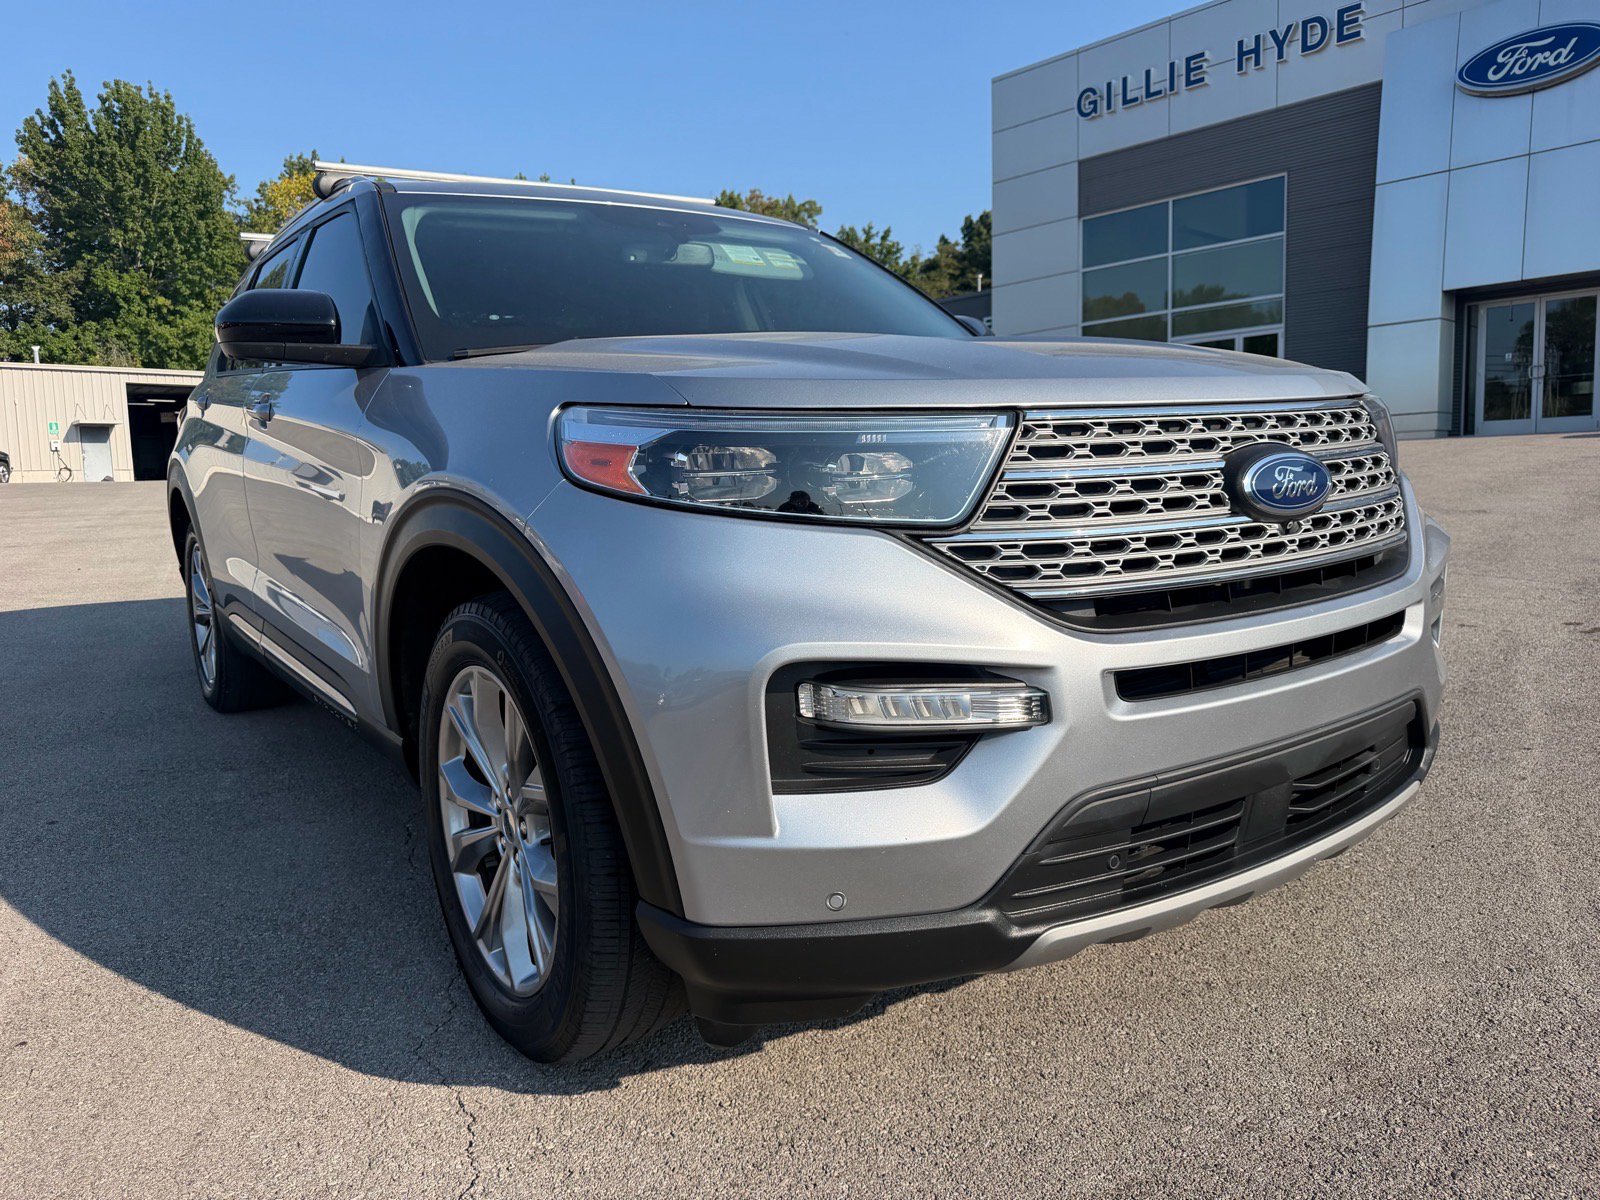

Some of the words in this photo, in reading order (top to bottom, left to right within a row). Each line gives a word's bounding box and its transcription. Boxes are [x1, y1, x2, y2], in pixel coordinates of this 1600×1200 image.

[1076, 51, 1208, 119] GILLIE
[1236, 2, 1364, 75] HYDE
[1487, 35, 1579, 82] Ford
[1272, 465, 1319, 500] Ford
